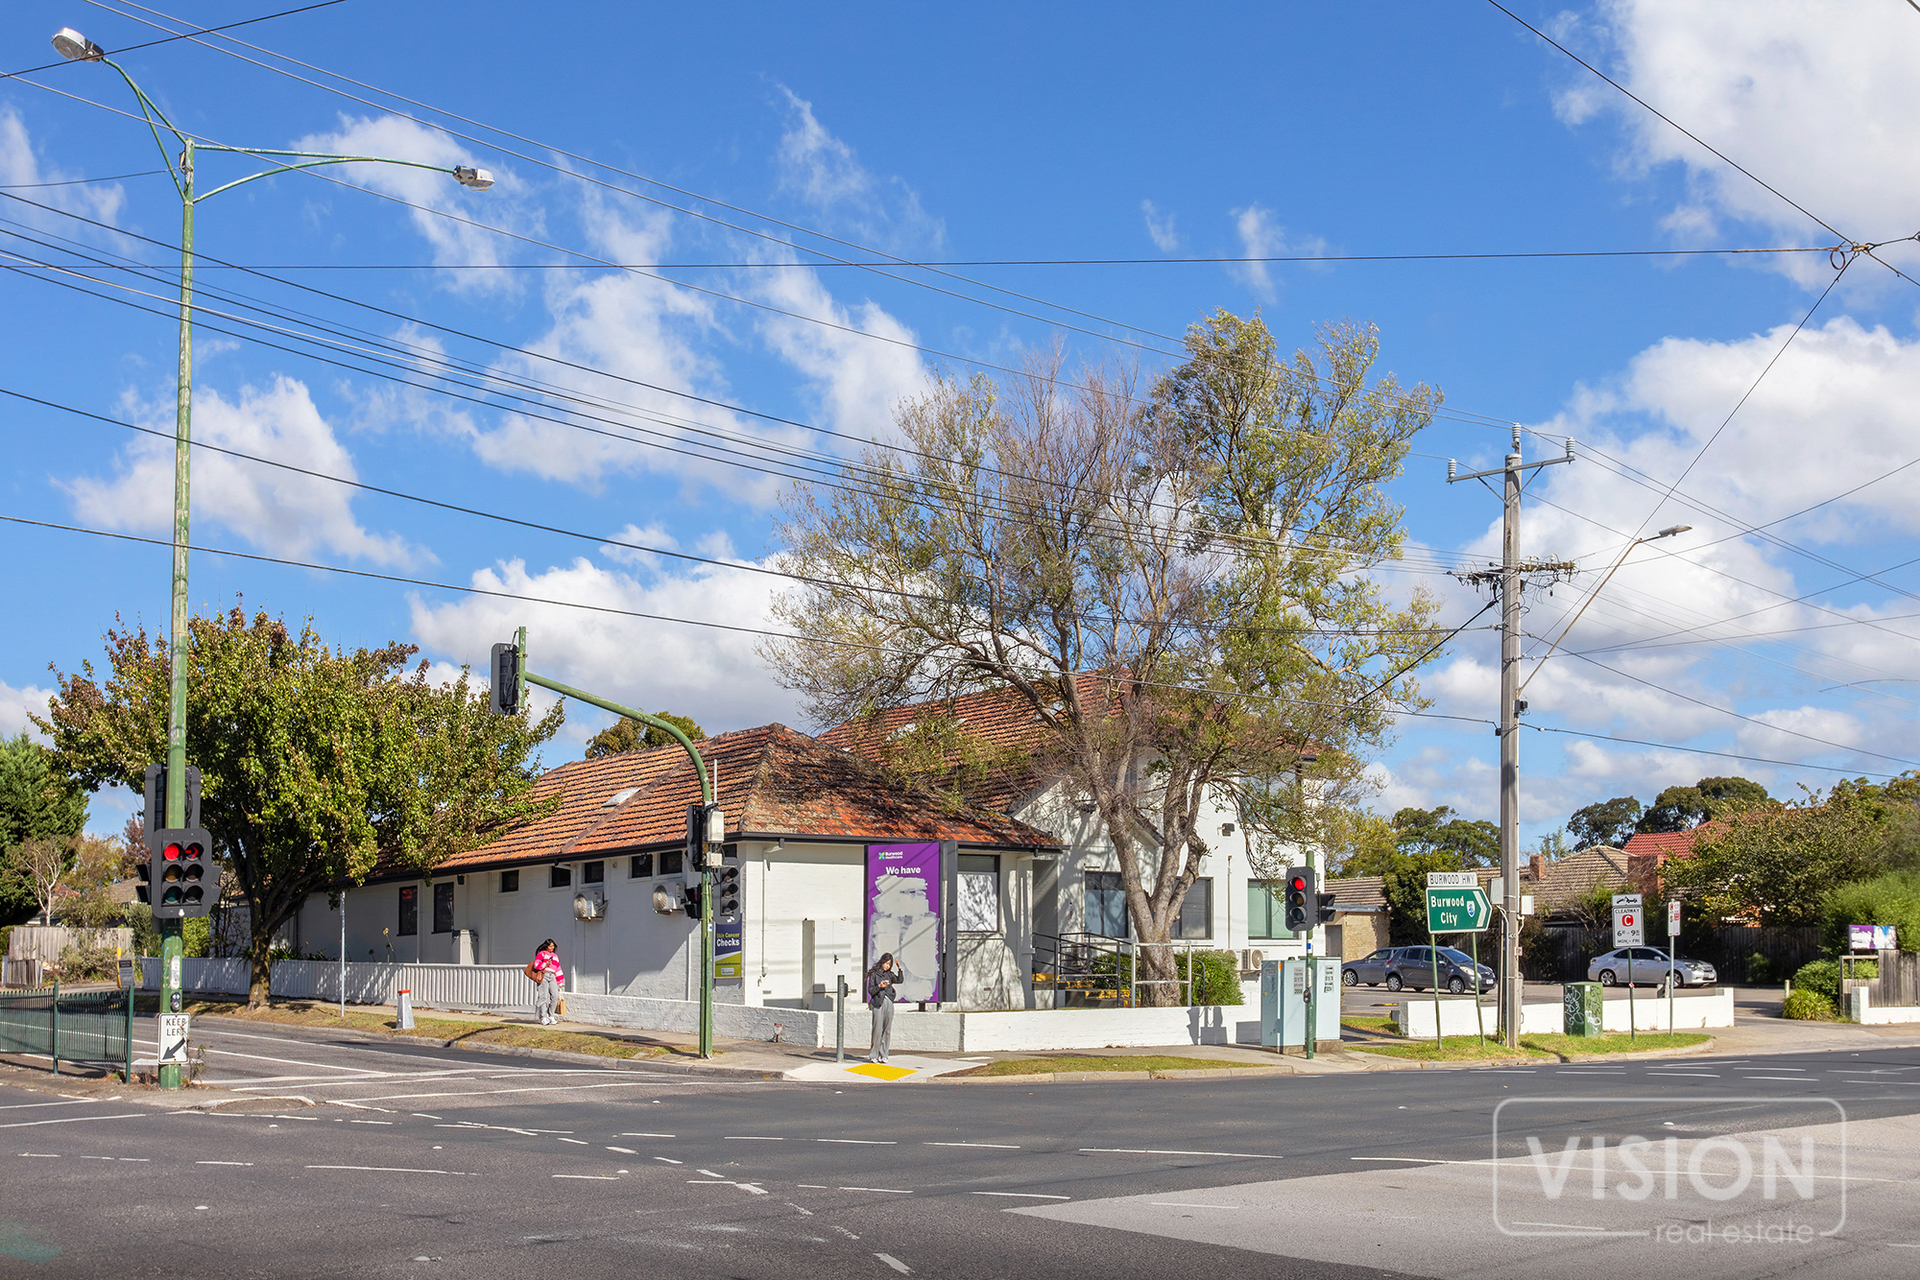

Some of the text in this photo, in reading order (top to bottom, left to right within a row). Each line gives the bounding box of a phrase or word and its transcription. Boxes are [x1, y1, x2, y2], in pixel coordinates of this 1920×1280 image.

[886, 866, 921, 875] We have
[1430, 874, 1475, 885] BURWOOD HWY
[1431, 895, 1464, 907] Burwood
[1440, 911, 1458, 927] City
[716, 938, 740, 947] Checks
[166, 1018, 186, 1026] KEEP
